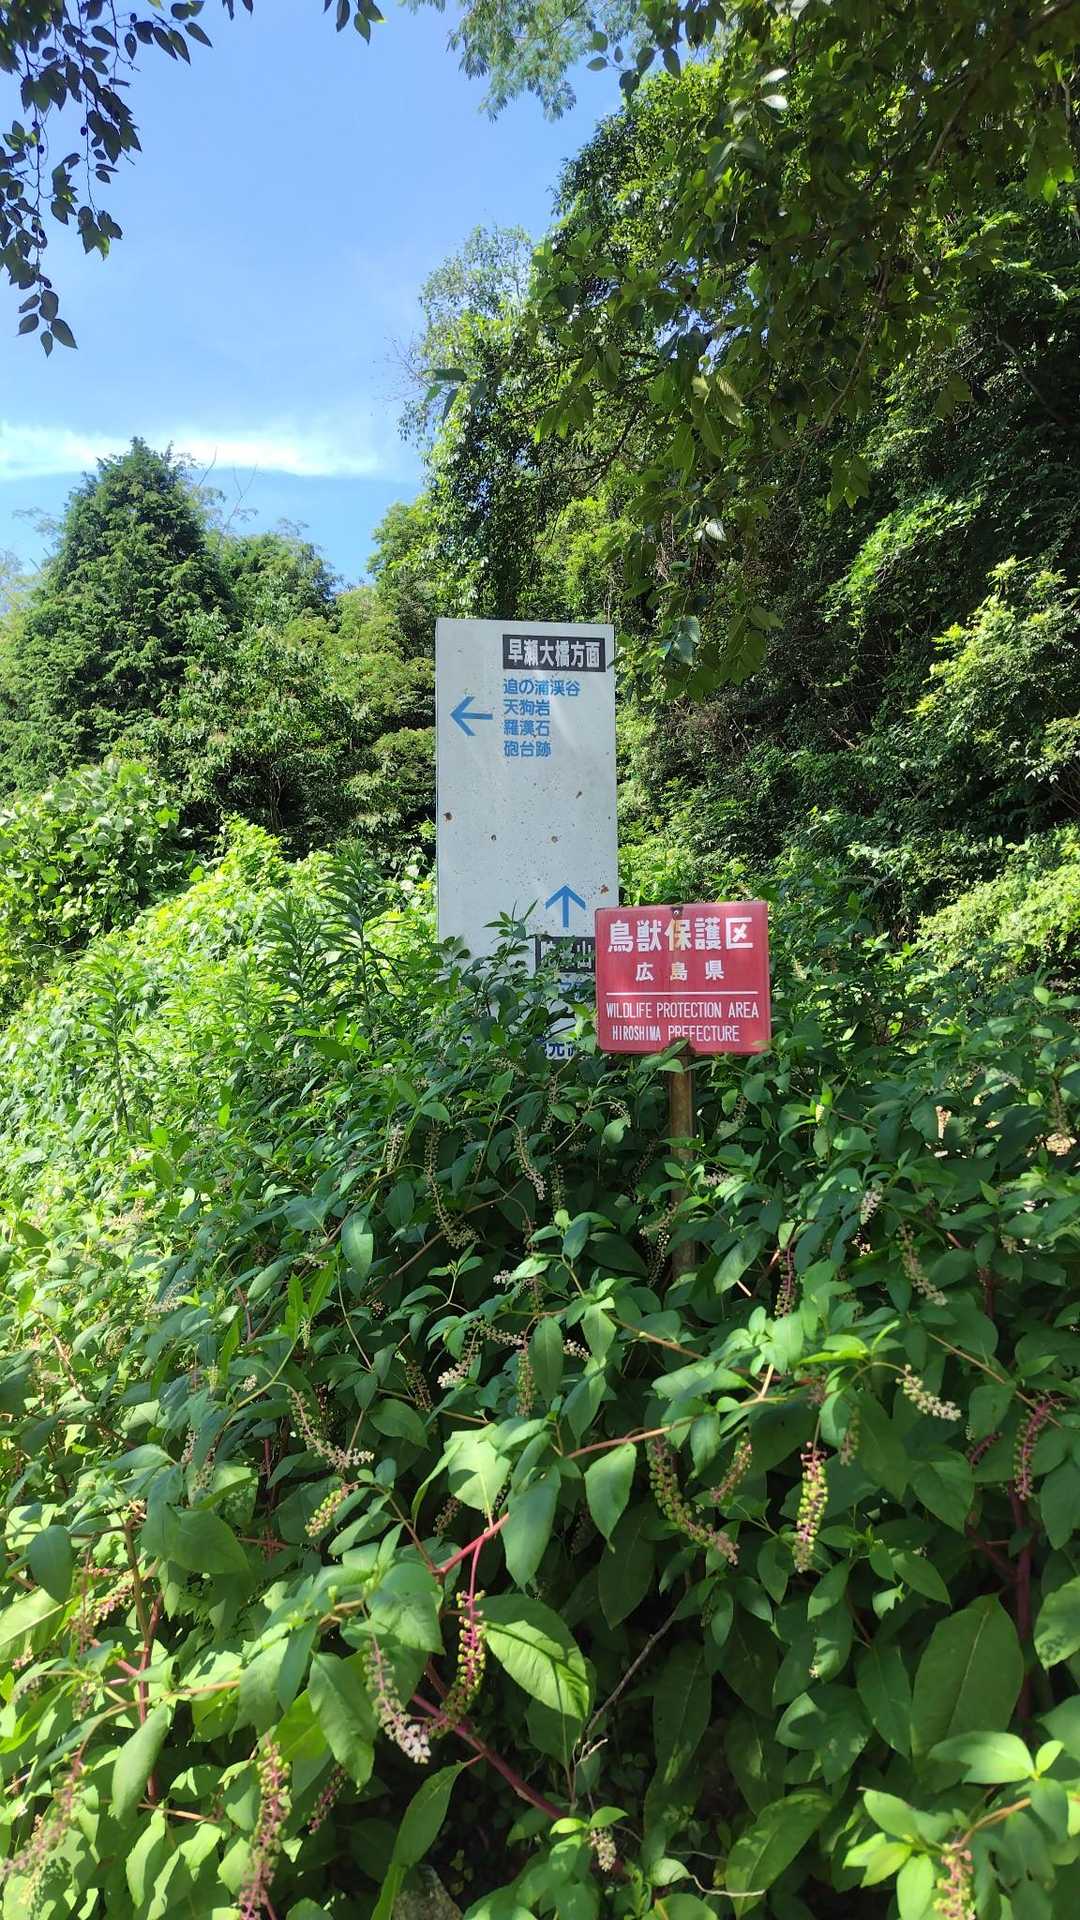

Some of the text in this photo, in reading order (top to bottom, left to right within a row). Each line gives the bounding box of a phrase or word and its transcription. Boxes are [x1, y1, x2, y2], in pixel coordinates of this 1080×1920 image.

[503, 699, 550, 716] 天狗岩
[503, 719, 551, 737] 羅漢石
[503, 740, 552, 758] 砲台跡
[608, 917, 754, 953] 鳥獣保護区
[606, 1001, 760, 1019] WILDLIFE PROTECTION AREA
[612, 1025, 740, 1042] HIROSHIMA PREFECTURE
